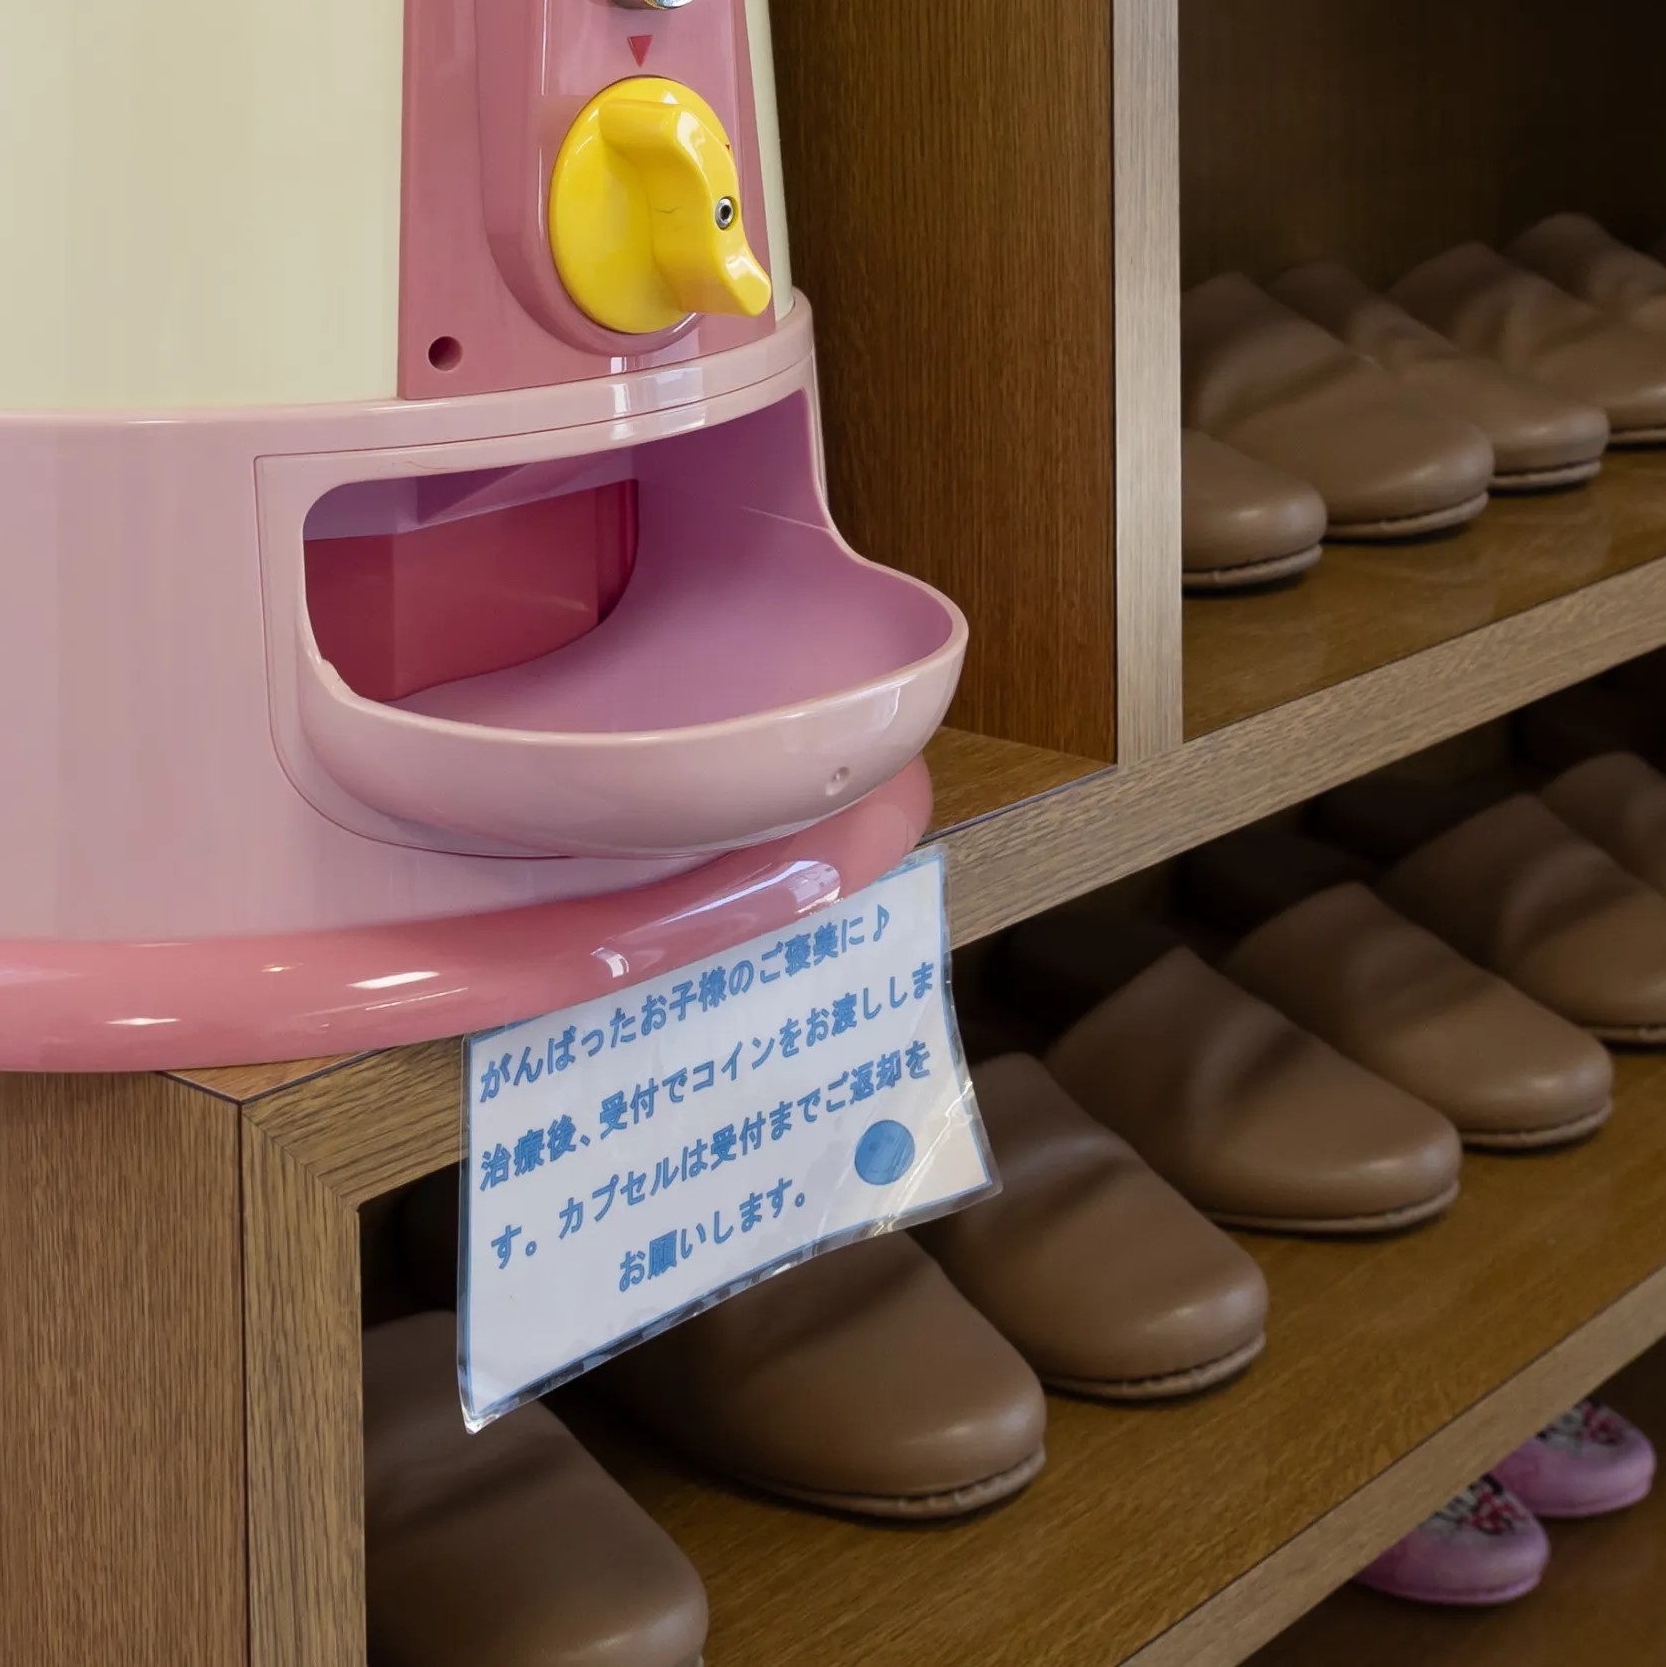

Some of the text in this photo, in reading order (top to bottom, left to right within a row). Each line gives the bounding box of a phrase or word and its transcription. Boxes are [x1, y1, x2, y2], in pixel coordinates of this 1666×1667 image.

[480, 961, 934, 1191] 治療後、受付でコインをお渡ししま
[619, 1177, 806, 1283] お願いします。
